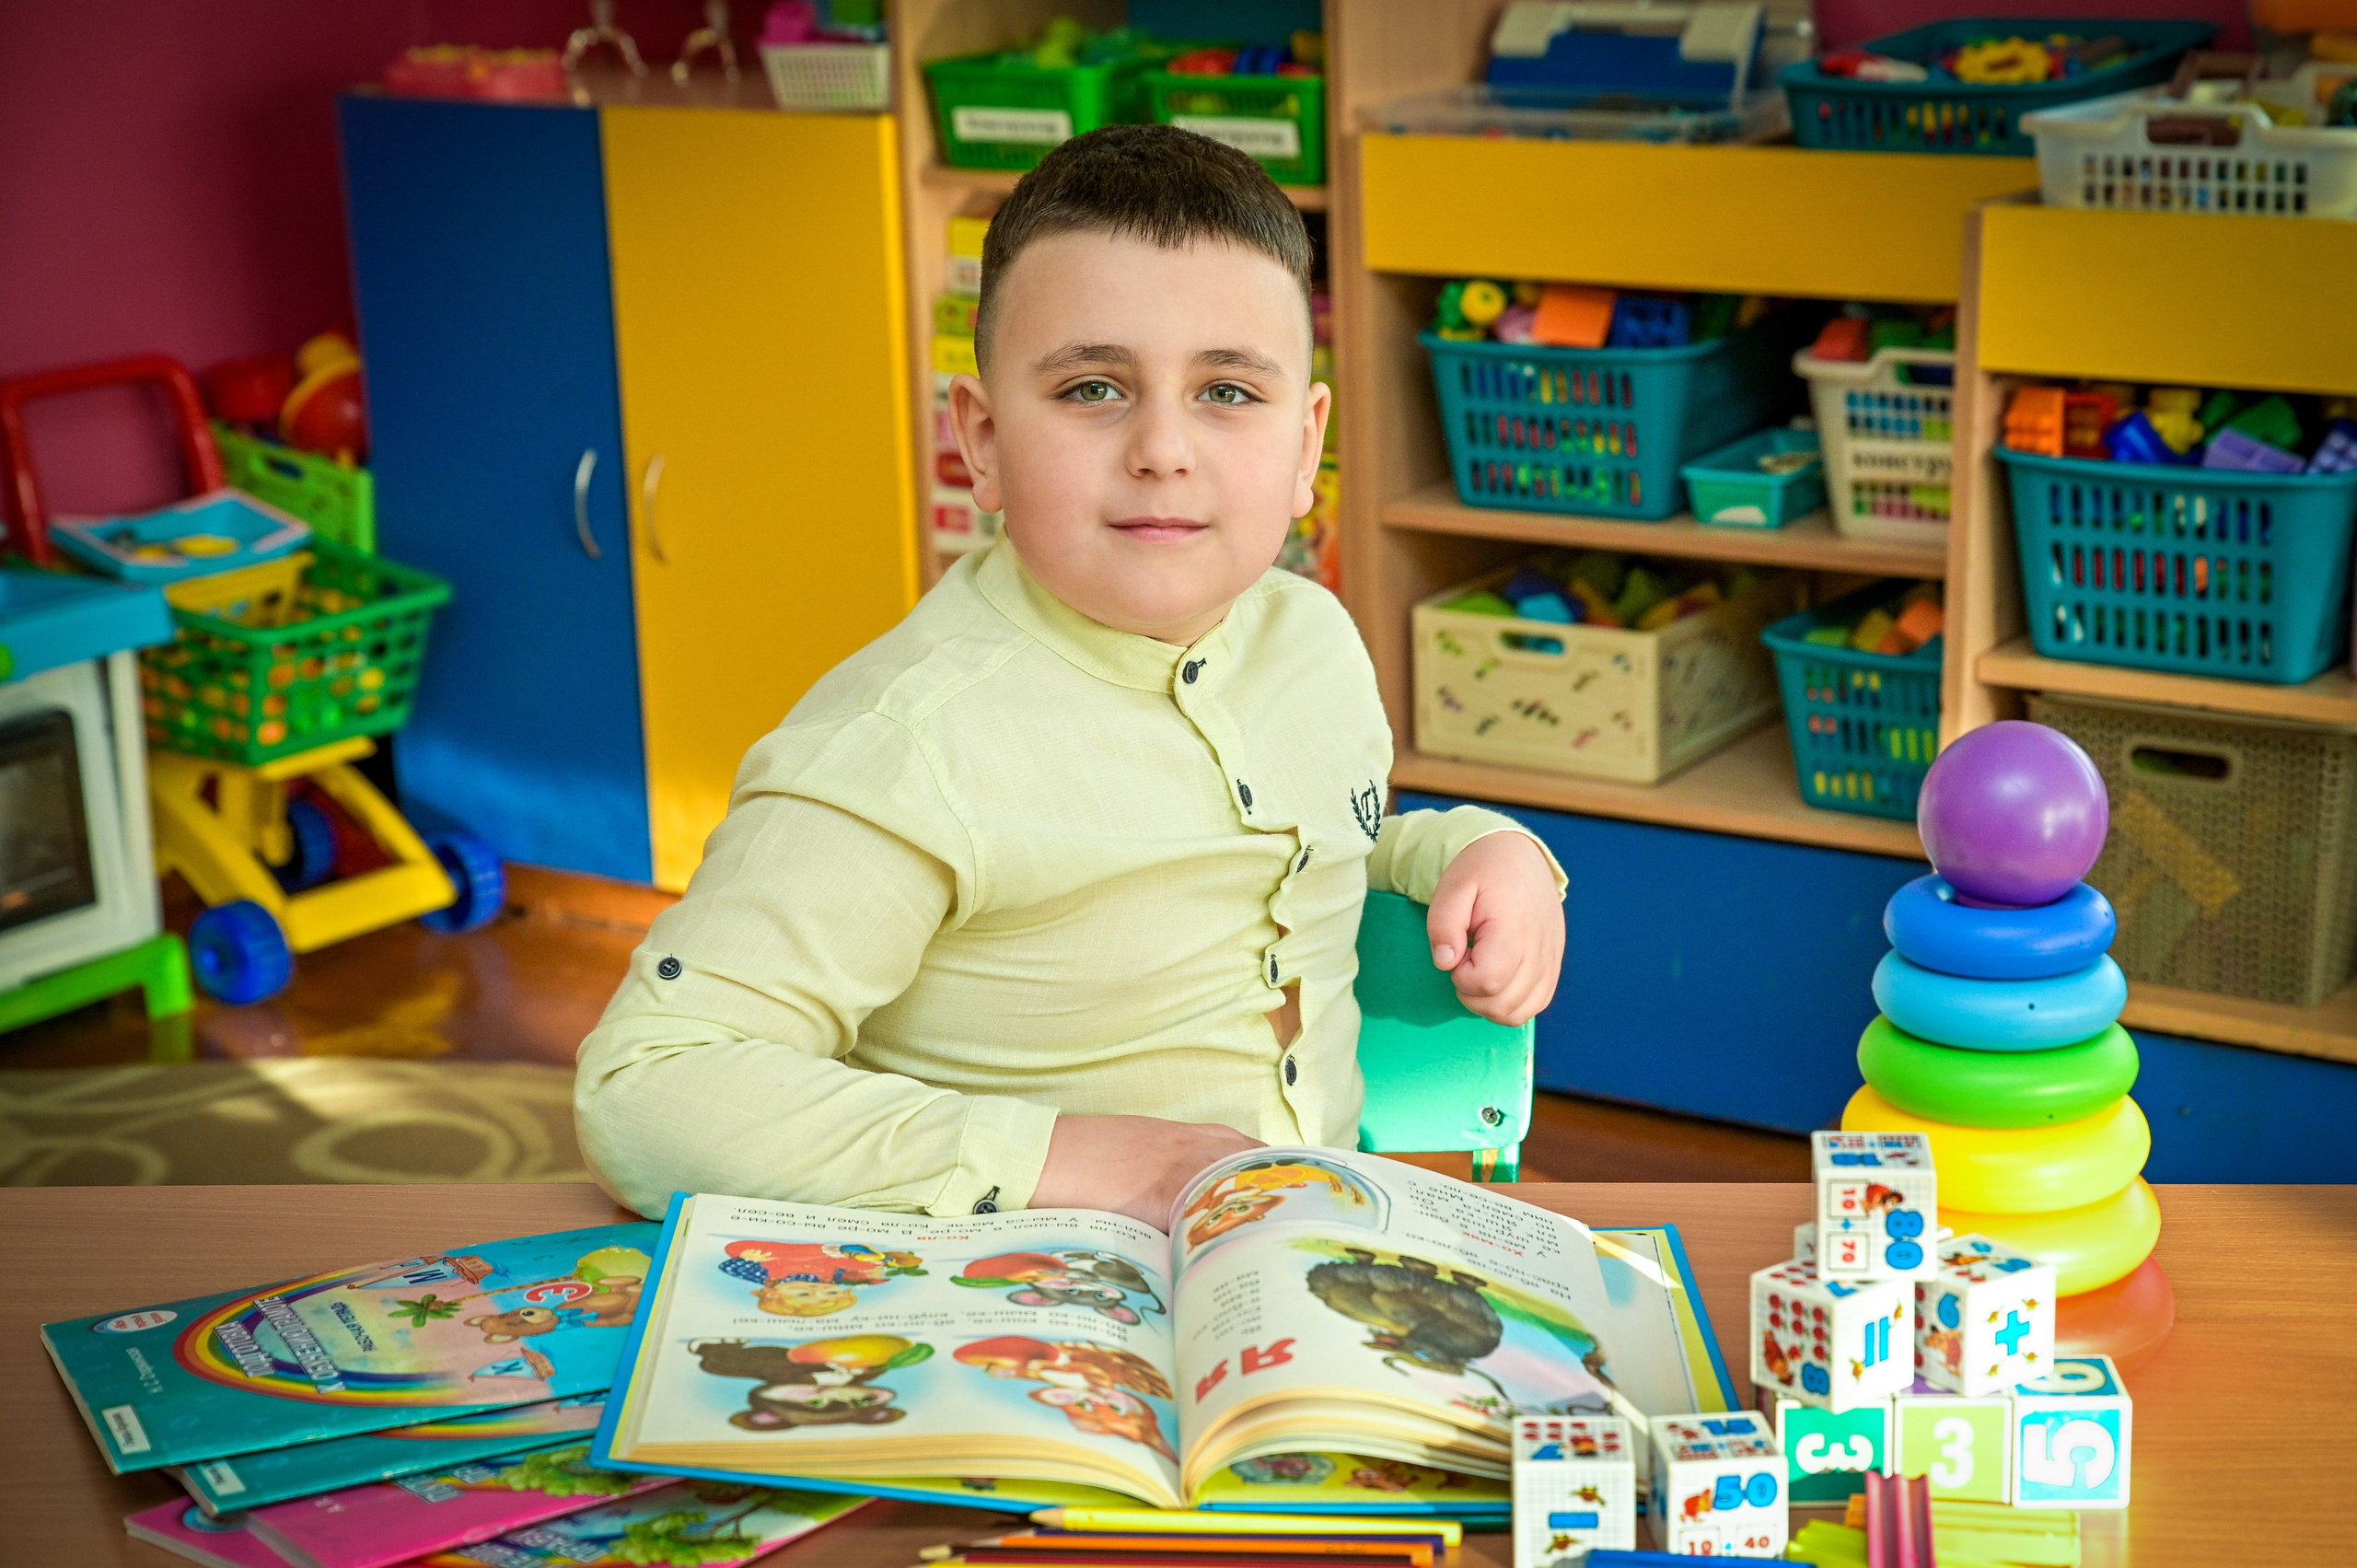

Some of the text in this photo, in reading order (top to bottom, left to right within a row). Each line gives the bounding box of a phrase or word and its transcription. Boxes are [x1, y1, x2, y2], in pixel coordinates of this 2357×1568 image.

[1428, 1186, 1464, 1202] Мне
[1439, 1182, 1553, 1225] ним ве-се-ло.
[730, 1215, 826, 1229] вы-со-ки-е
[733, 1208, 795, 1218] ве-сел.
[828, 1217, 870, 1225] смел
[881, 1221, 929, 1229] Ко-ля
[1004, 1216, 1058, 1225] мы-са
[1410, 1194, 1559, 1248] мяк Яш-ка. Он
[1413, 1210, 1449, 1225] бан-
[1462, 1203, 1518, 1227] Яш-ка
[1477, 1202, 1524, 1222] смел.
[1014, 1222, 1078, 1230] вы-шел
[1089, 1225, 1137, 1240] Ко-ля
[1090, 1218, 1152, 1239] вол-ны.
[1411, 1202, 1561, 1255] ке шур-шал хо-
[1536, 1222, 1556, 1233] но
[1842, 1189, 1856, 1263] 10 70
[1886, 1208, 1924, 1270] 80
[1462, 1230, 1524, 1258] Хо-мяк
[1478, 1230, 1526, 1250] ме-ня
[1400, 1230, 1570, 1292] крас-но-е яб-ло-ко.
[1467, 1259, 1572, 1302] На яб-ло-не
[1937, 1293, 1959, 1329] 6
[213, 1320, 276, 1379] ПОДГОТОВКА
[252, 1295, 348, 1395] К ОБУЧЕНИЮ ГРАМОТЕ
[1240, 1338, 1296, 1376] Я
[1930, 1416, 1974, 1489] 3
[2022, 1418, 2116, 1489] 5
[1713, 1472, 1778, 1511] 50
[1745, 1536, 1770, 1549] 40
